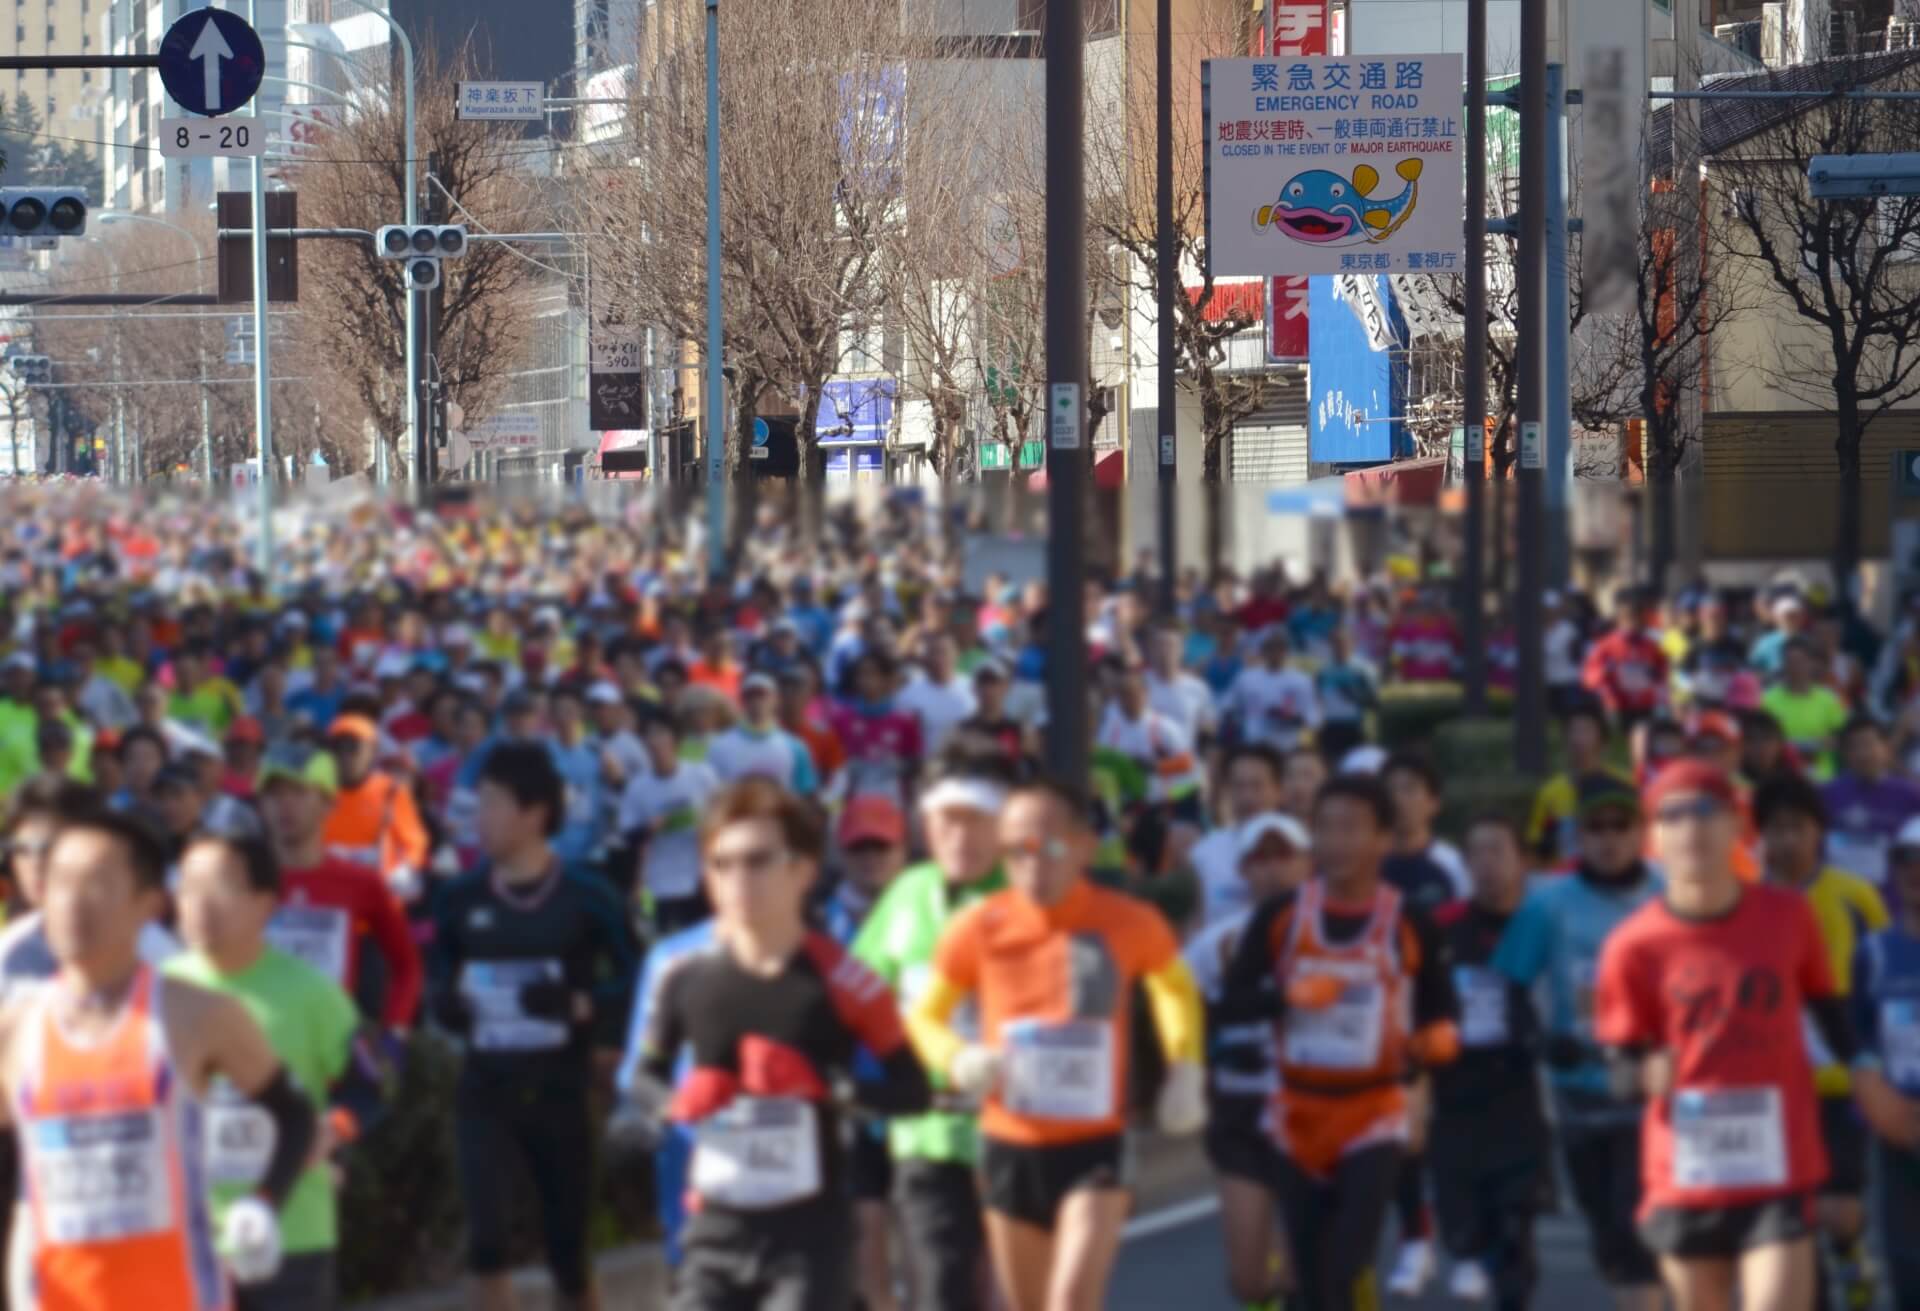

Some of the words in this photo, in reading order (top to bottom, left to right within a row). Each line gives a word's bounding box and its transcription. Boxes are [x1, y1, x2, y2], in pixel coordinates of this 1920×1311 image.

[1251, 62, 1423, 91] 緊急交通路
[467, 88, 536, 103] 神楽坂下
[1255, 96, 1359, 112] EMERGENCY
[1371, 94, 1418, 109] ROAD
[1218, 117, 1456, 141] 地震災害時、一般車両通行禁止
[1222, 144, 1261, 156] CLOSED
[1264, 144, 1273, 156] IN
[1278, 144, 1296, 155] THE
[1299, 143, 1330, 155] EVENT
[1334, 143, 1347, 154] OF
[1350, 142, 1384, 154] MAJOR
[1387, 141, 1452, 153] EARTHQUAKE
